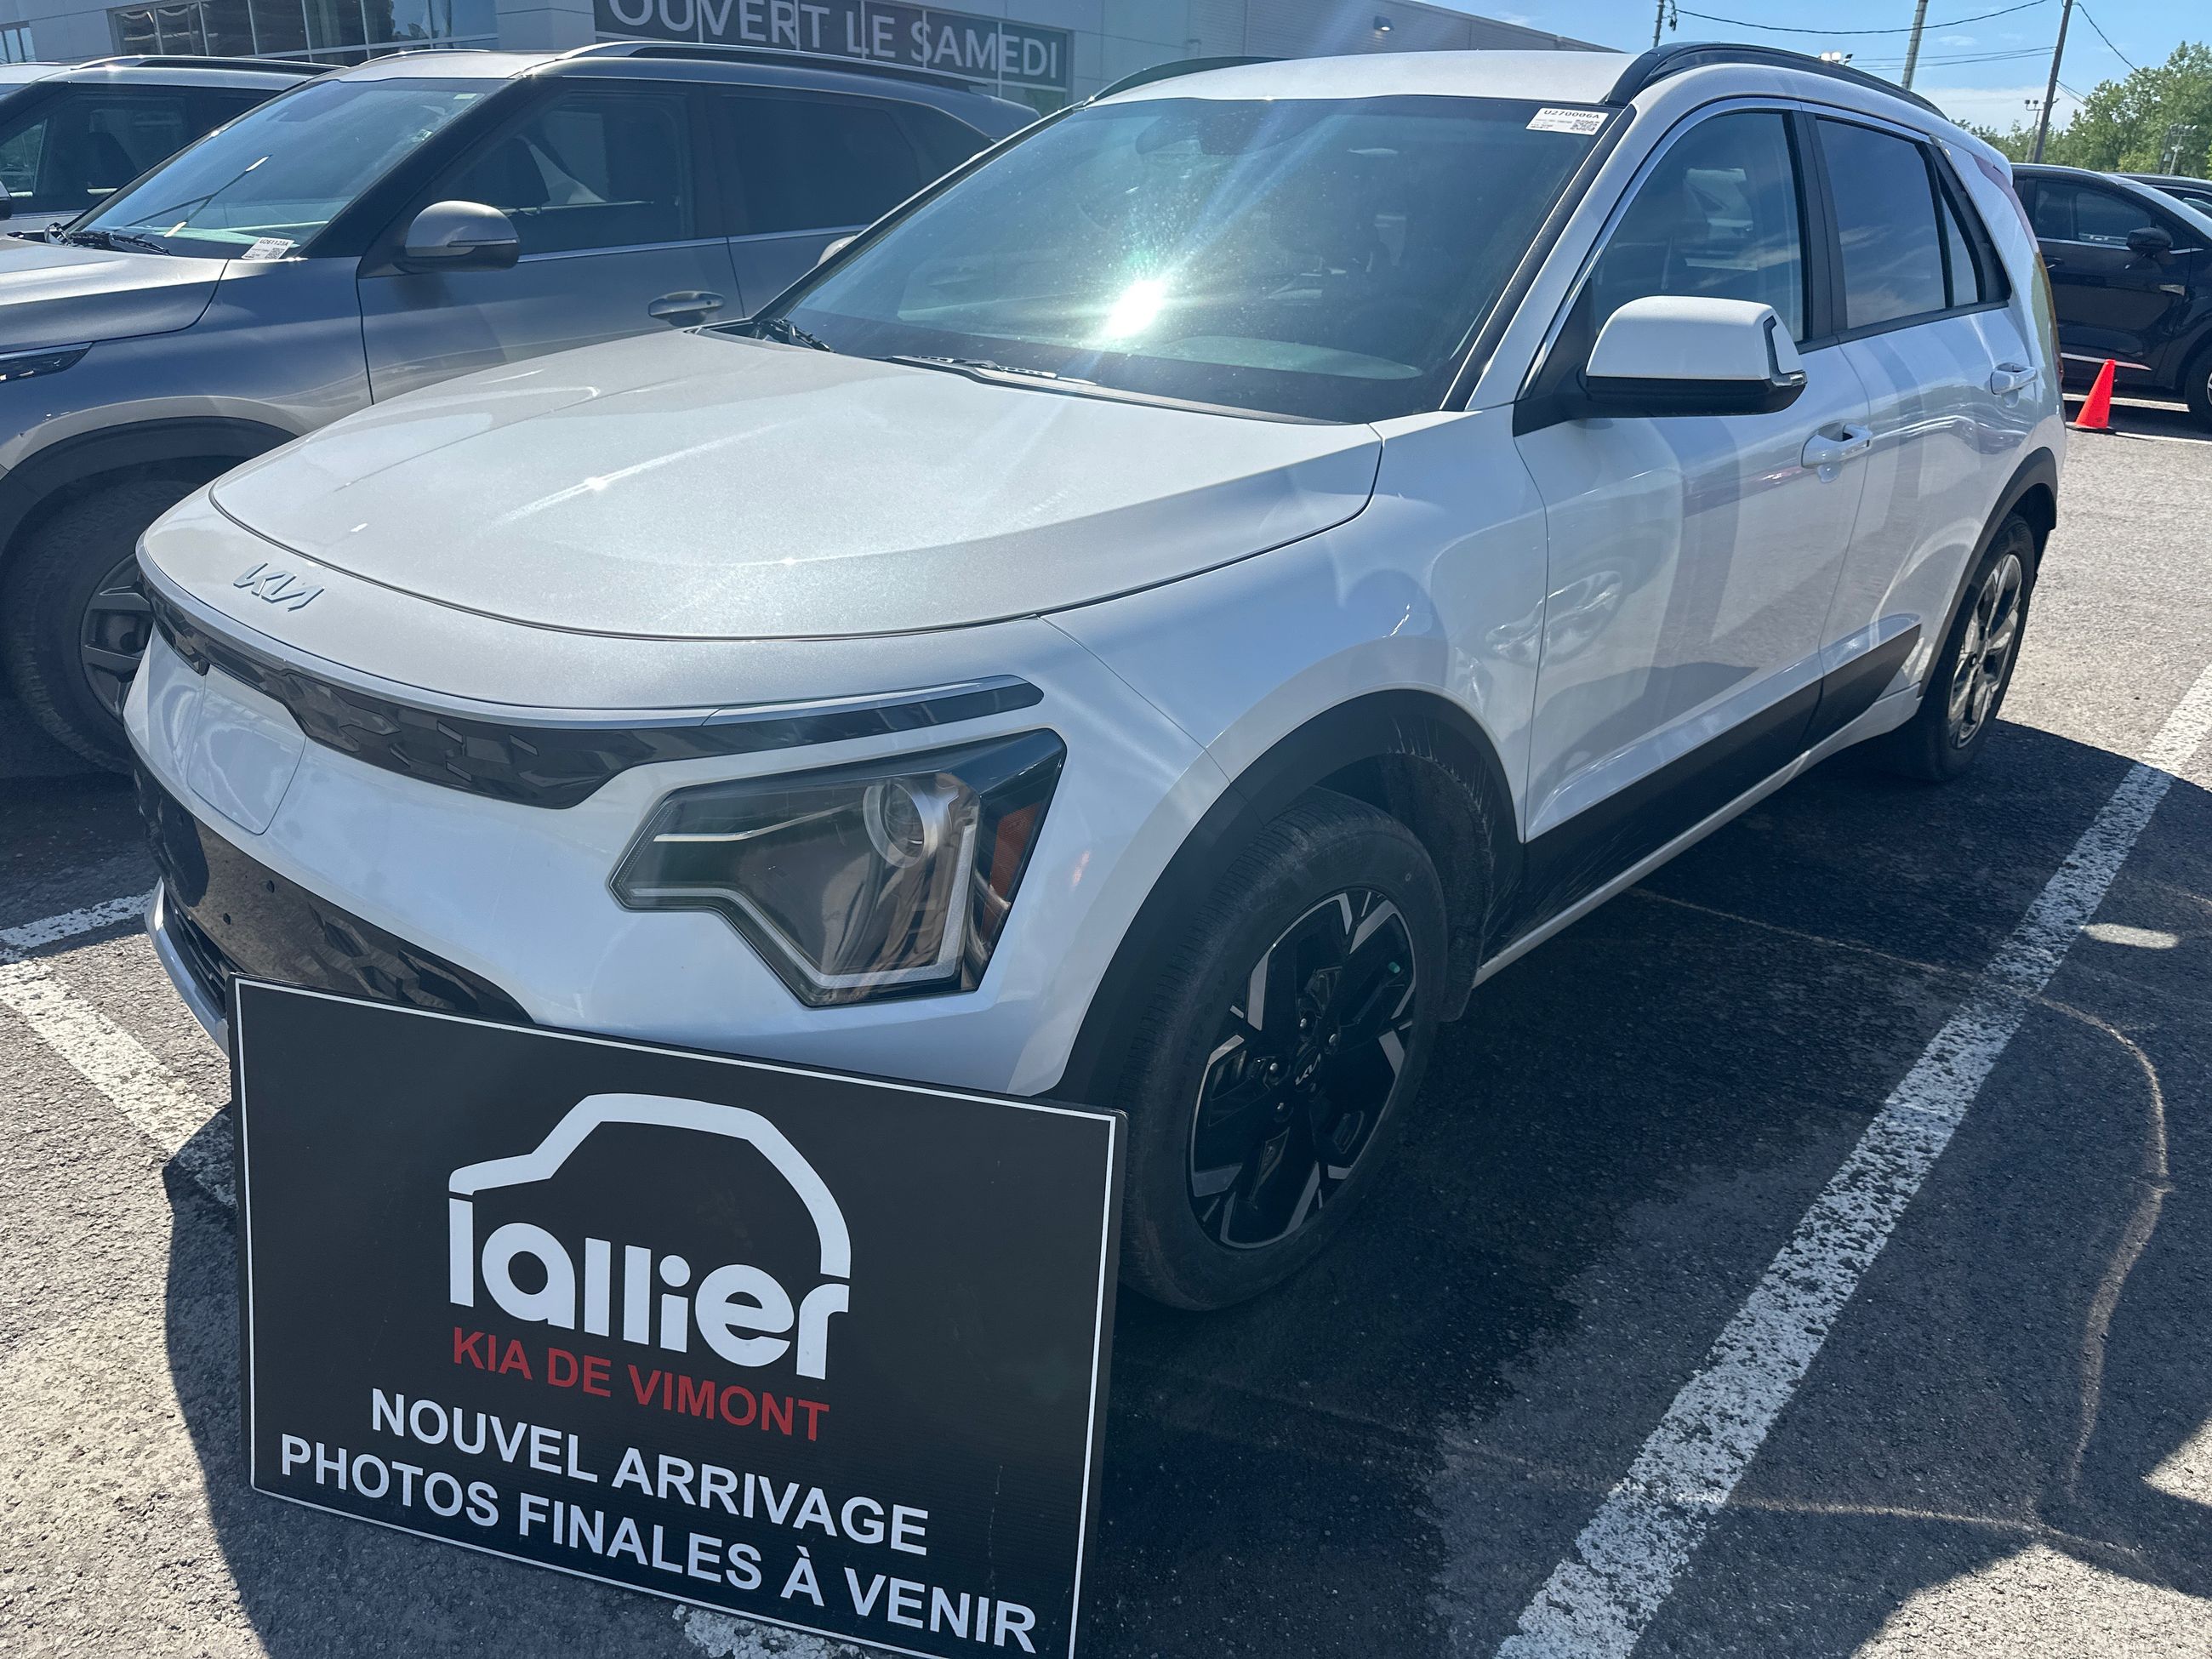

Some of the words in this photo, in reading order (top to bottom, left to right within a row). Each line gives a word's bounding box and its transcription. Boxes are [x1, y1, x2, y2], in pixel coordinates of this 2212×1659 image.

[610, 0, 830, 49] OUVERT
[846, 10, 896, 59] LE
[909, 20, 1058, 79] SAMEDI
[453, 1327, 532, 1380] KIA
[547, 1347, 612, 1396] DE
[628, 1365, 830, 1441] VIMONT
[372, 1388, 598, 1483] NOUVEL
[611, 1447, 929, 1556] ARRIVAGE
[282, 1433, 499, 1526] PHOTOS
[519, 1492, 762, 1590] FINALES
[780, 1546, 825, 1608] À
[844, 1566, 1036, 1654] VENIR
